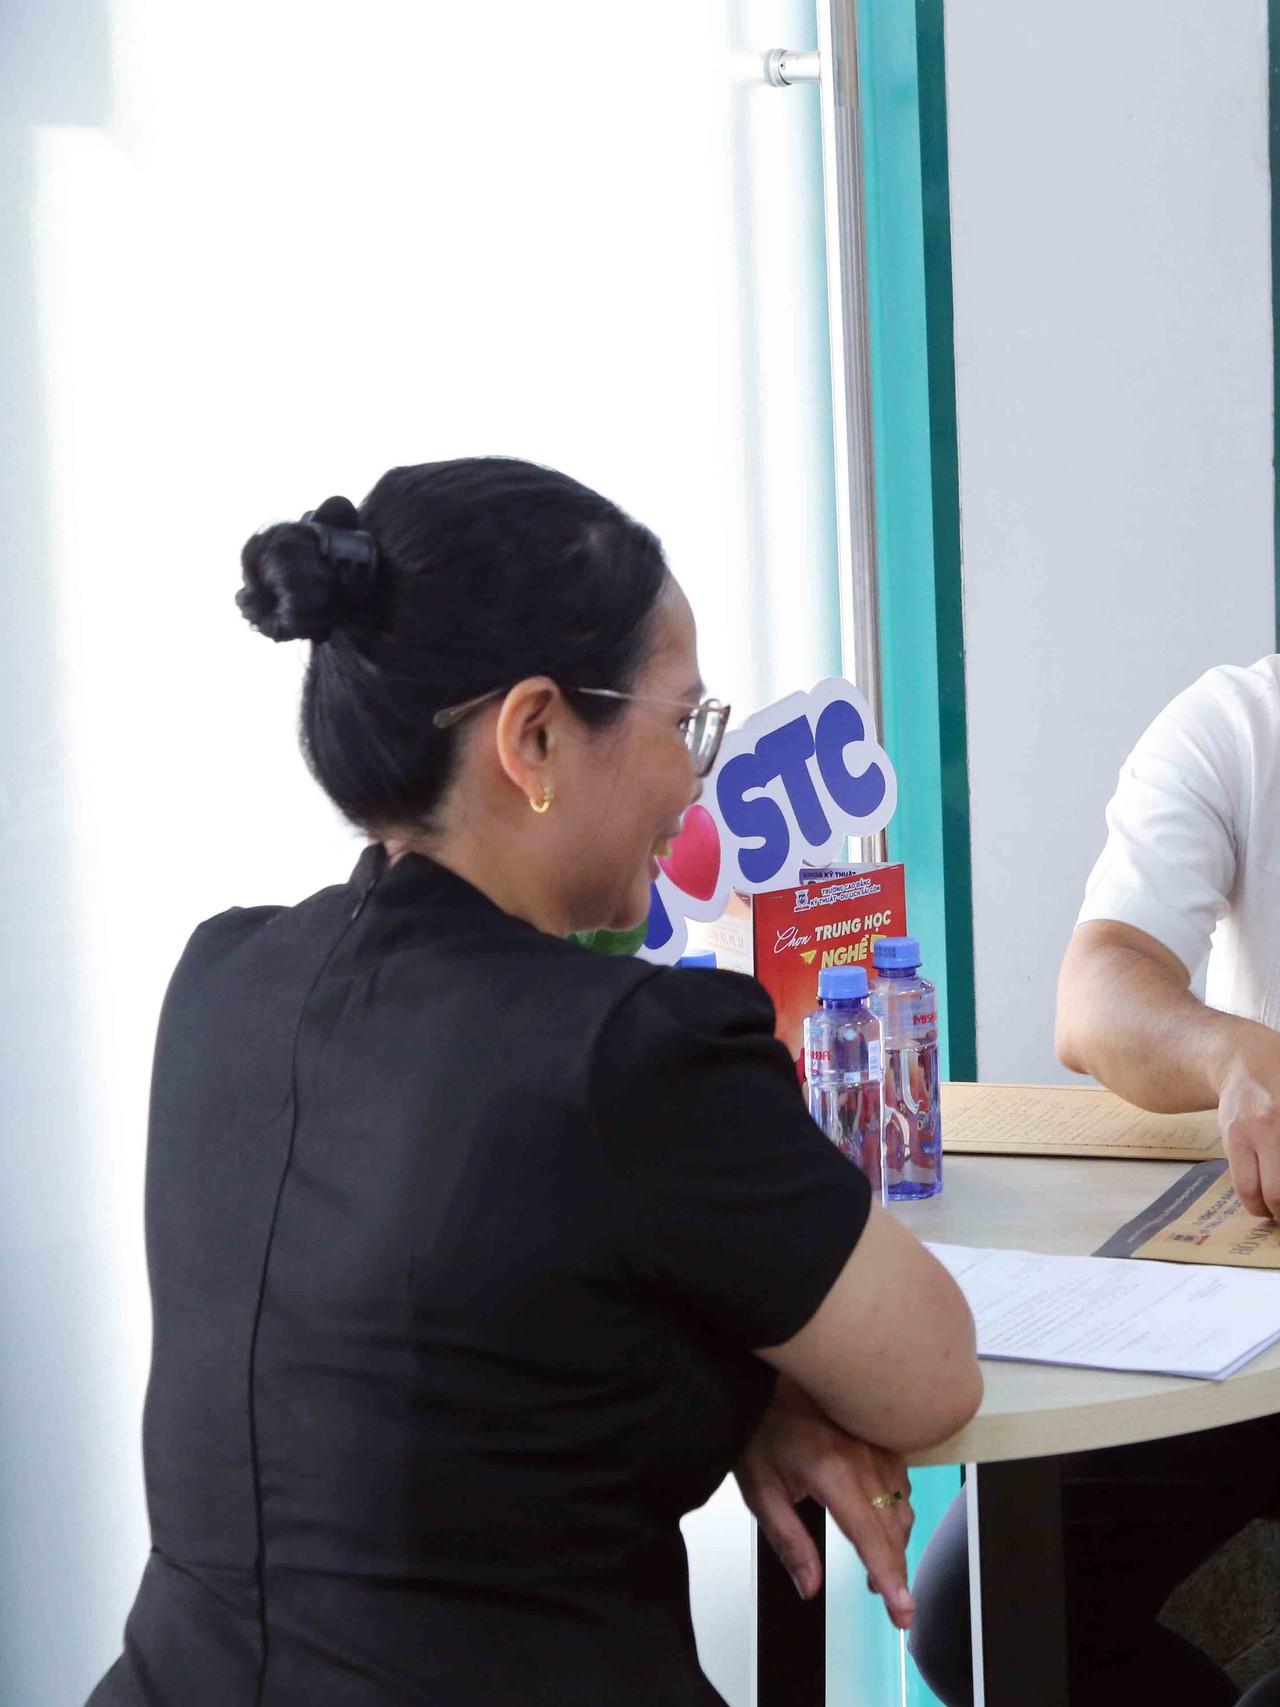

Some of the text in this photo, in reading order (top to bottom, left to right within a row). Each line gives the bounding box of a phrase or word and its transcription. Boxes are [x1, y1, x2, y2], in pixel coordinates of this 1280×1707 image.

[716, 700, 886, 883] STC
[844, 883, 856, 891] CAO
[773, 926, 812, 953] Chọn
[815, 918, 861, 941] TRUNG
[864, 910, 892, 932] HỌC
[821, 934, 870, 969] NGHỀ
